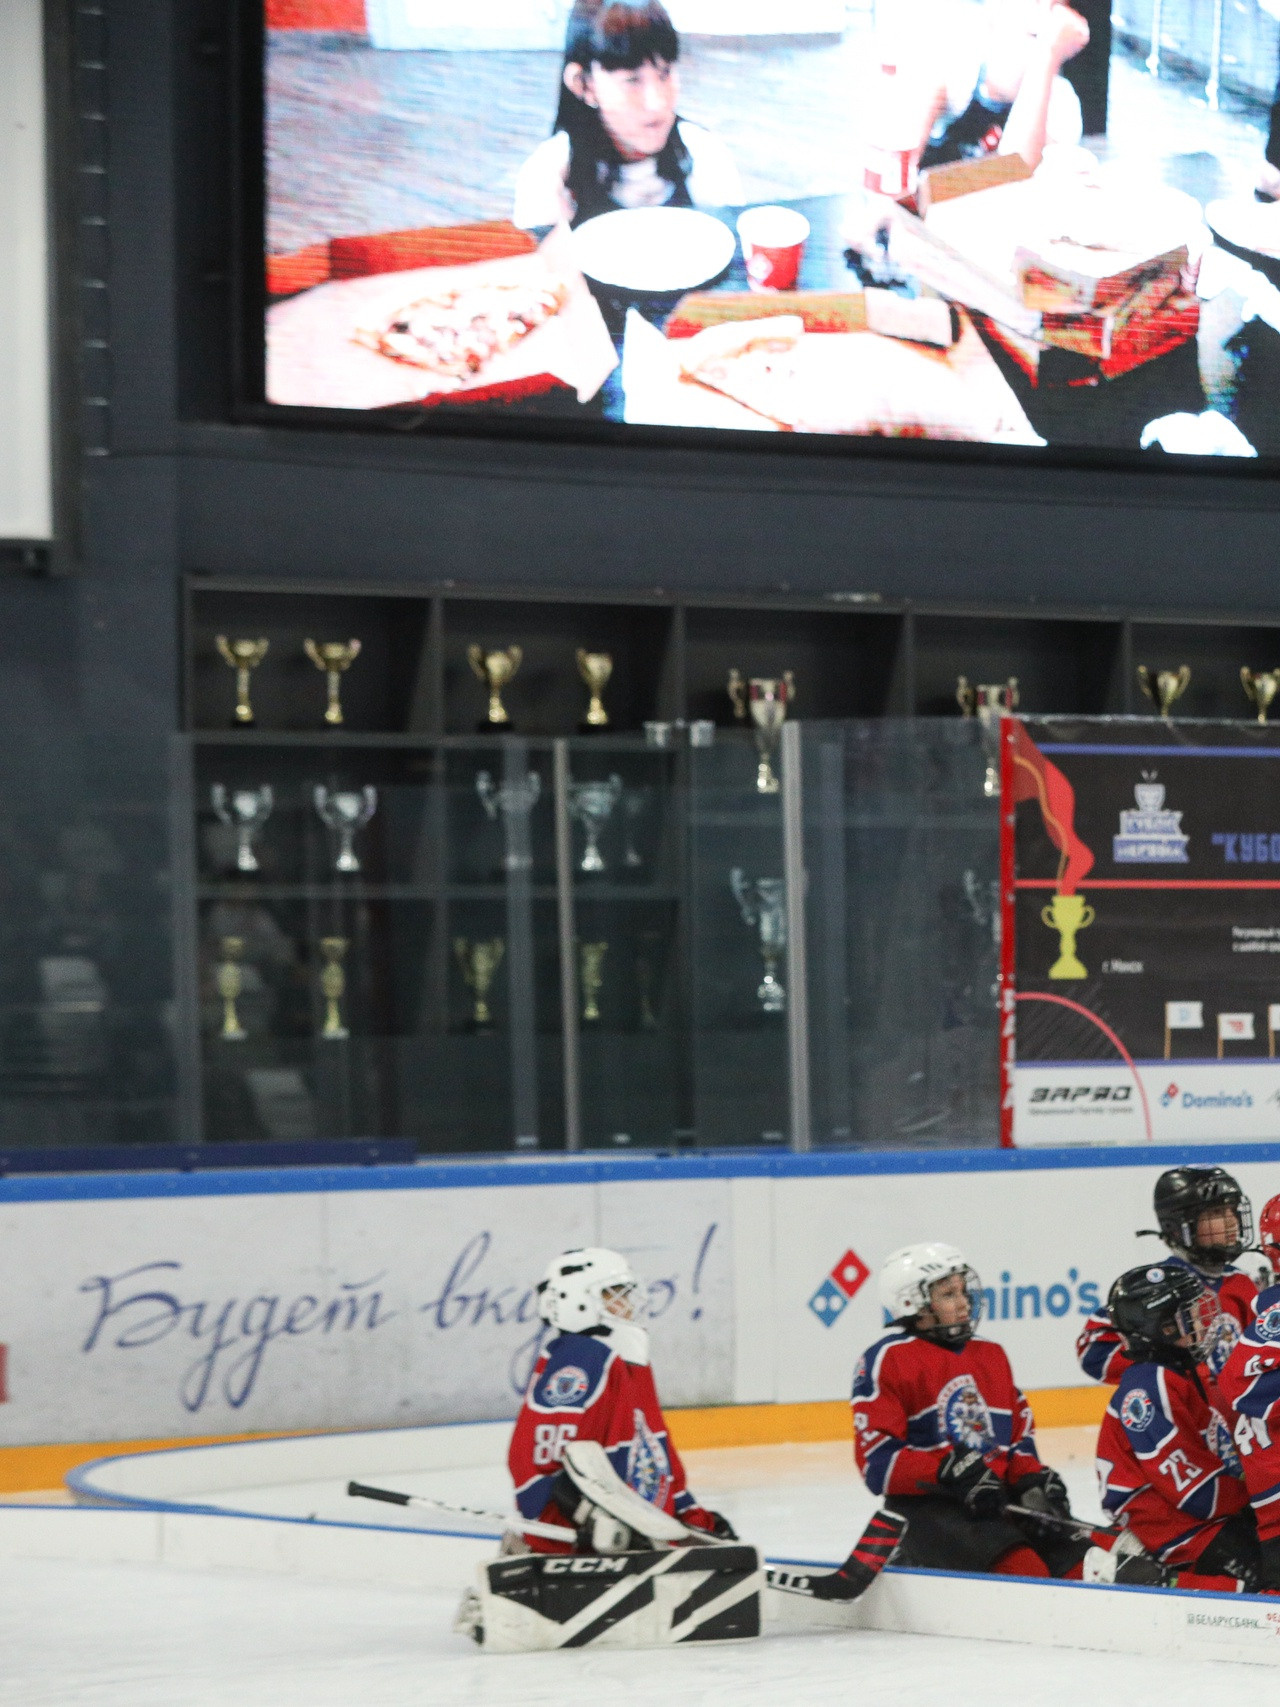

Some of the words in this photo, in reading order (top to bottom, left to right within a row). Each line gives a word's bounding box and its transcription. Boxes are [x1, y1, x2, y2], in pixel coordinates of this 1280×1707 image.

[80, 1261, 396, 1413] Будет
[421, 1222, 718, 1395] вкуо!
[533, 1424, 578, 1465] 86
[1158, 1449, 1203, 1492] 23
[543, 1557, 628, 1574] CCM
